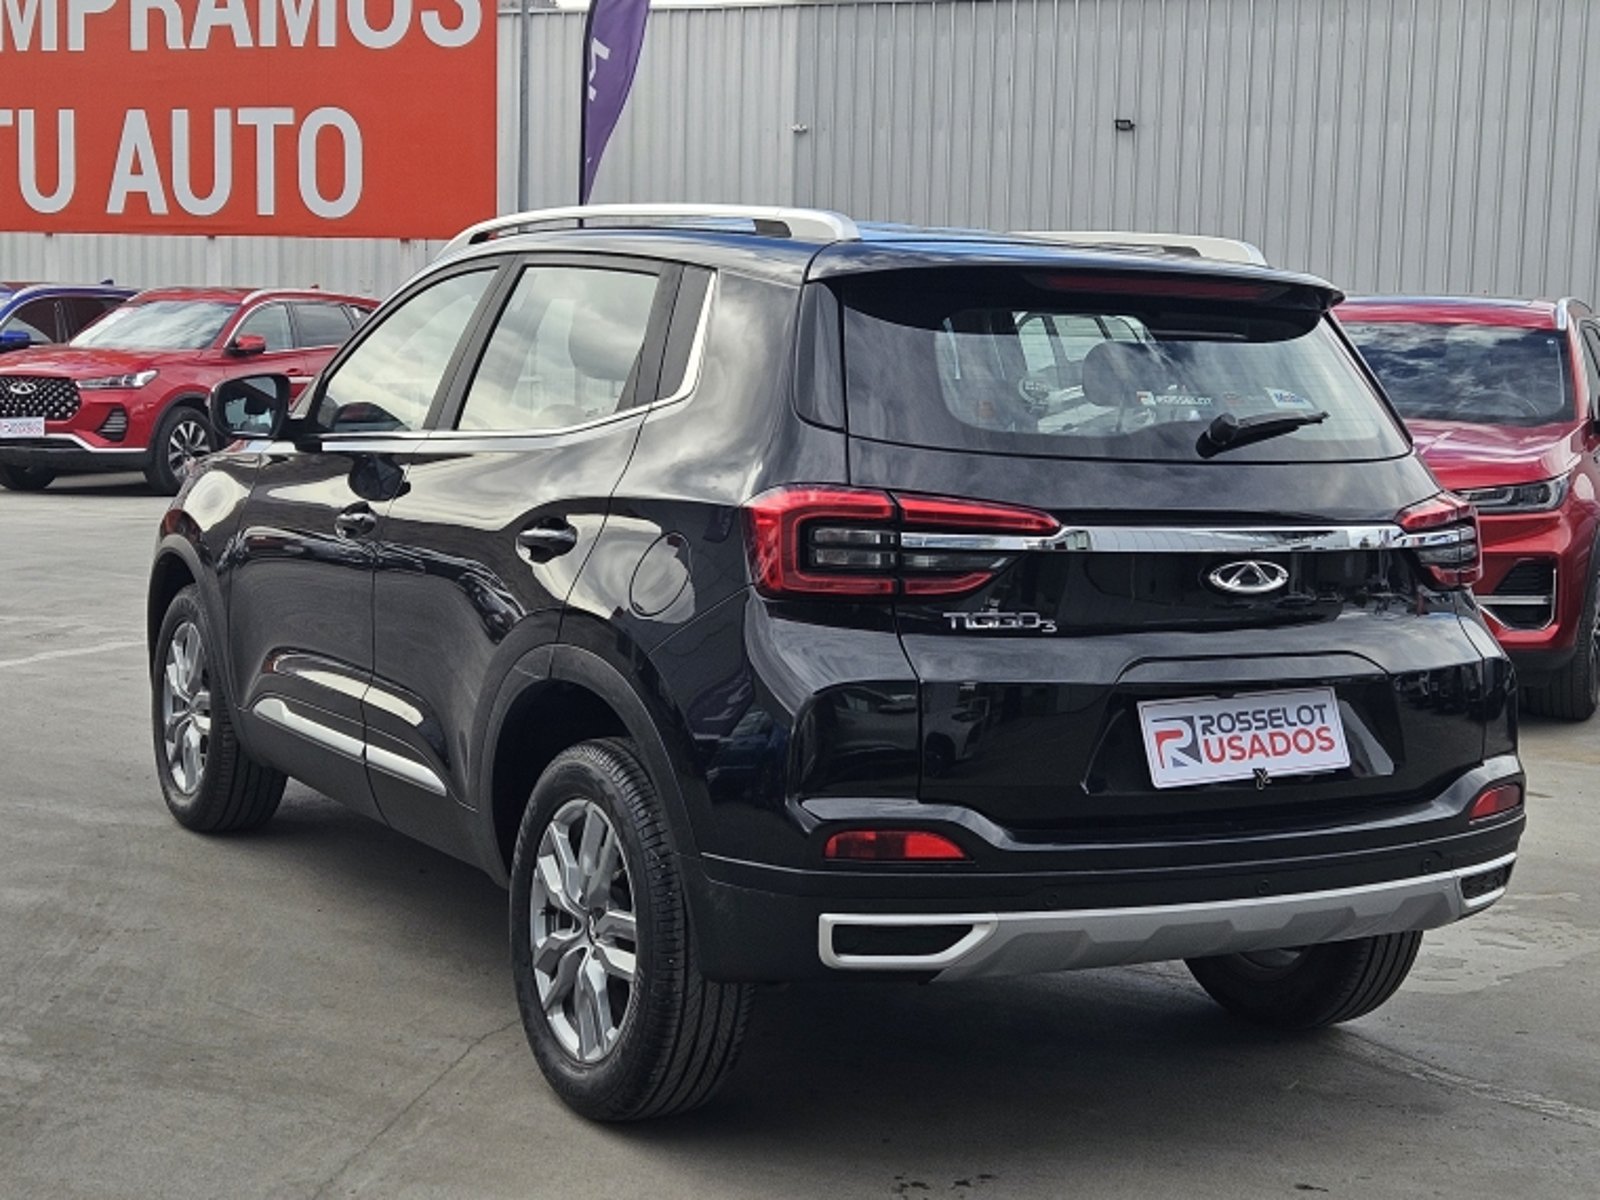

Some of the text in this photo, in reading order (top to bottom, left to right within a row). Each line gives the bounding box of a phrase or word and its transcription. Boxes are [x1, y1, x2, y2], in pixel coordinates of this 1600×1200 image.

[0, 106, 363, 218] U AUTO
[1200, 703, 1328, 735] ROSSELOT
[1203, 726, 1336, 764] USADOS
